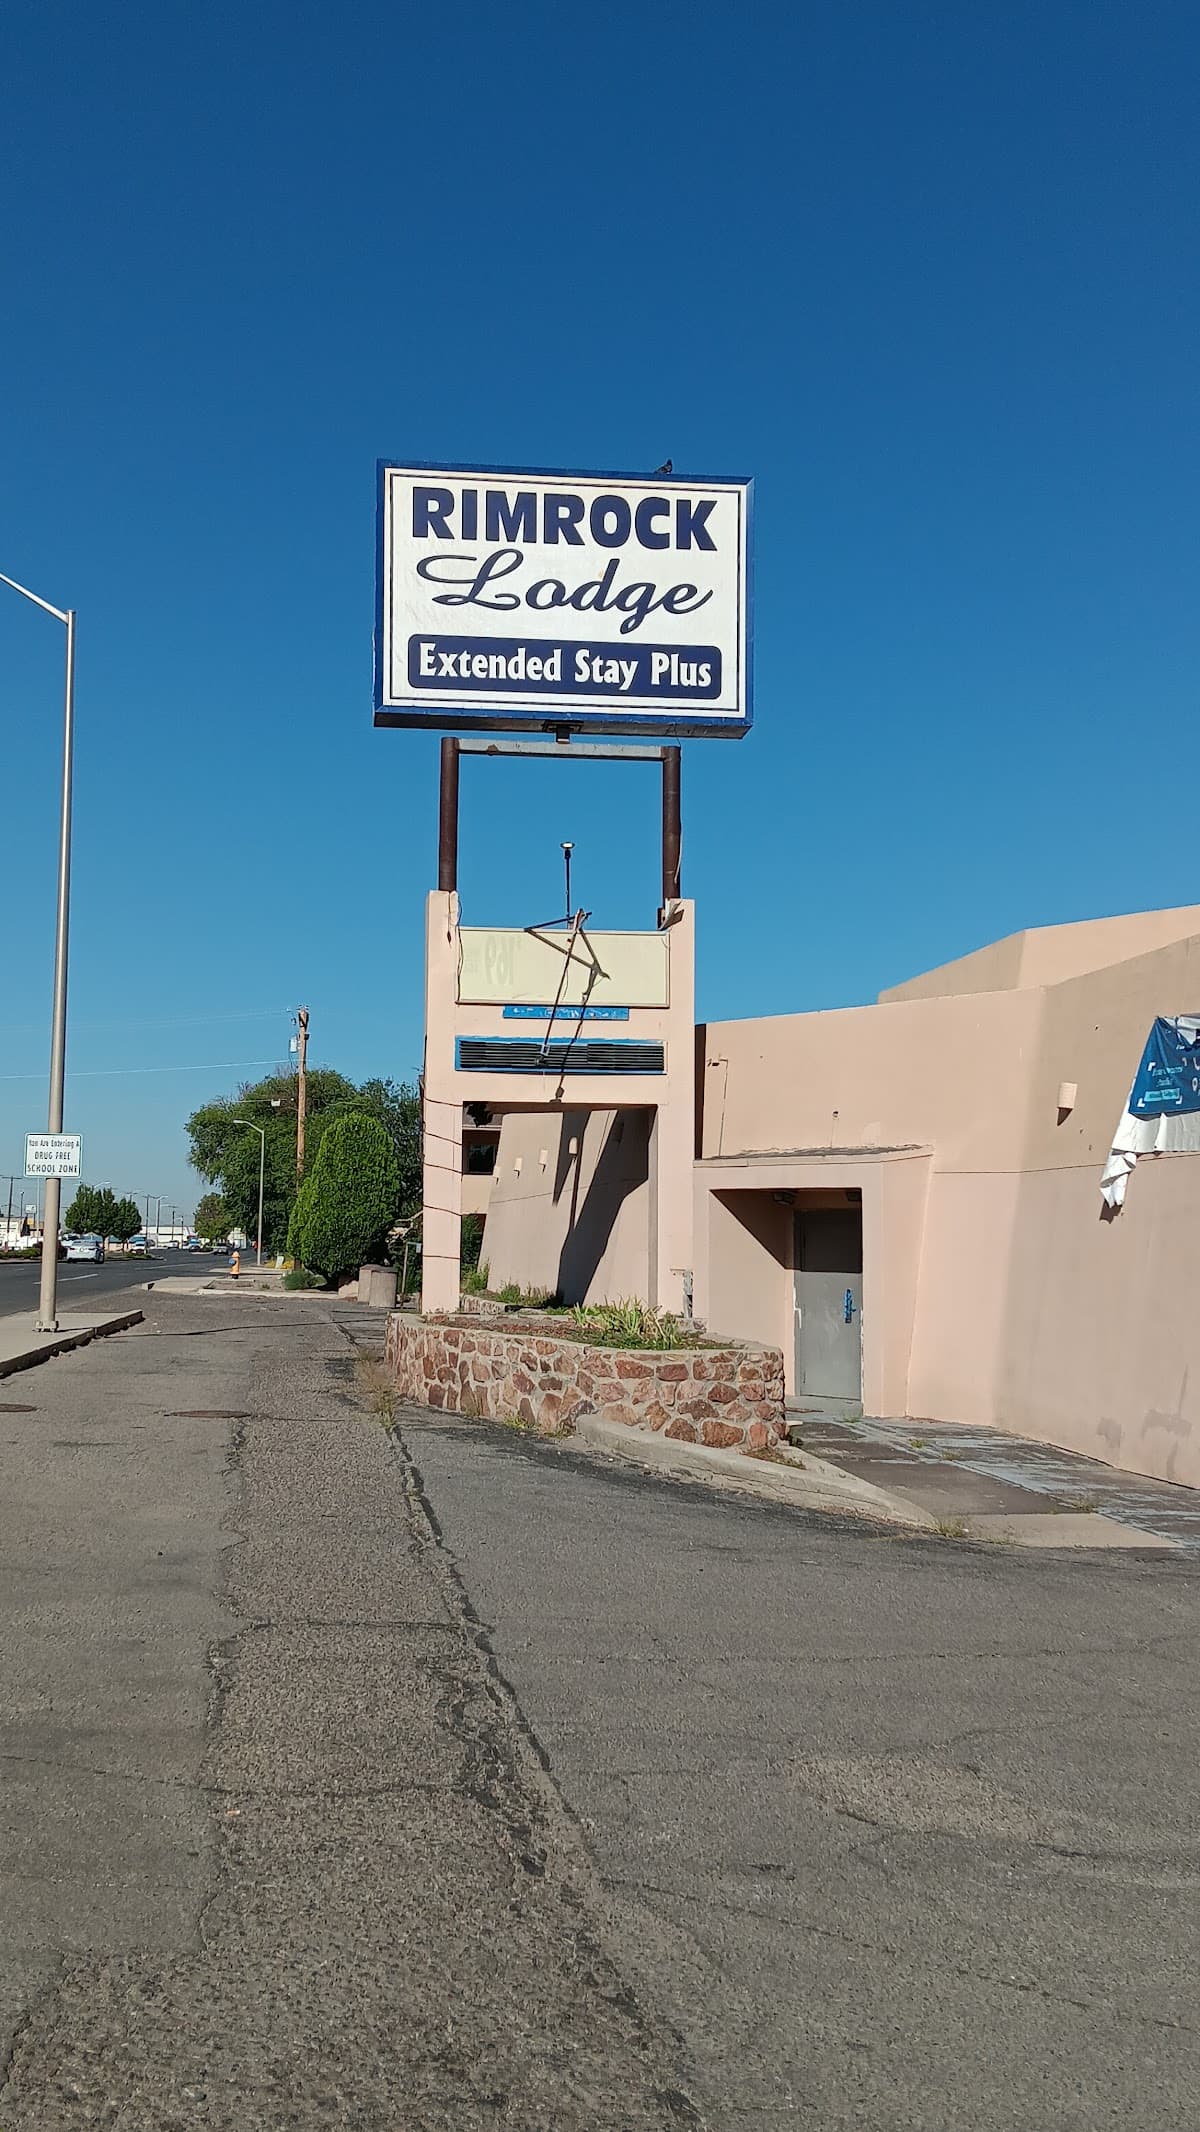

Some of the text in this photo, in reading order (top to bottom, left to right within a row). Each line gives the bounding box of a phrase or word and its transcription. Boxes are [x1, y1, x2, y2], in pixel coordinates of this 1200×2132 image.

[412, 487, 717, 551] RIMROCK
[416, 548, 713, 635] Lodge
[419, 642, 712, 691] Extended Stay Plus
[34, 1151, 71, 1160] DRUG FREE
[51, 1139, 74, 1149] Entering
[27, 1164, 78, 1173] SCHOOL ZONE
